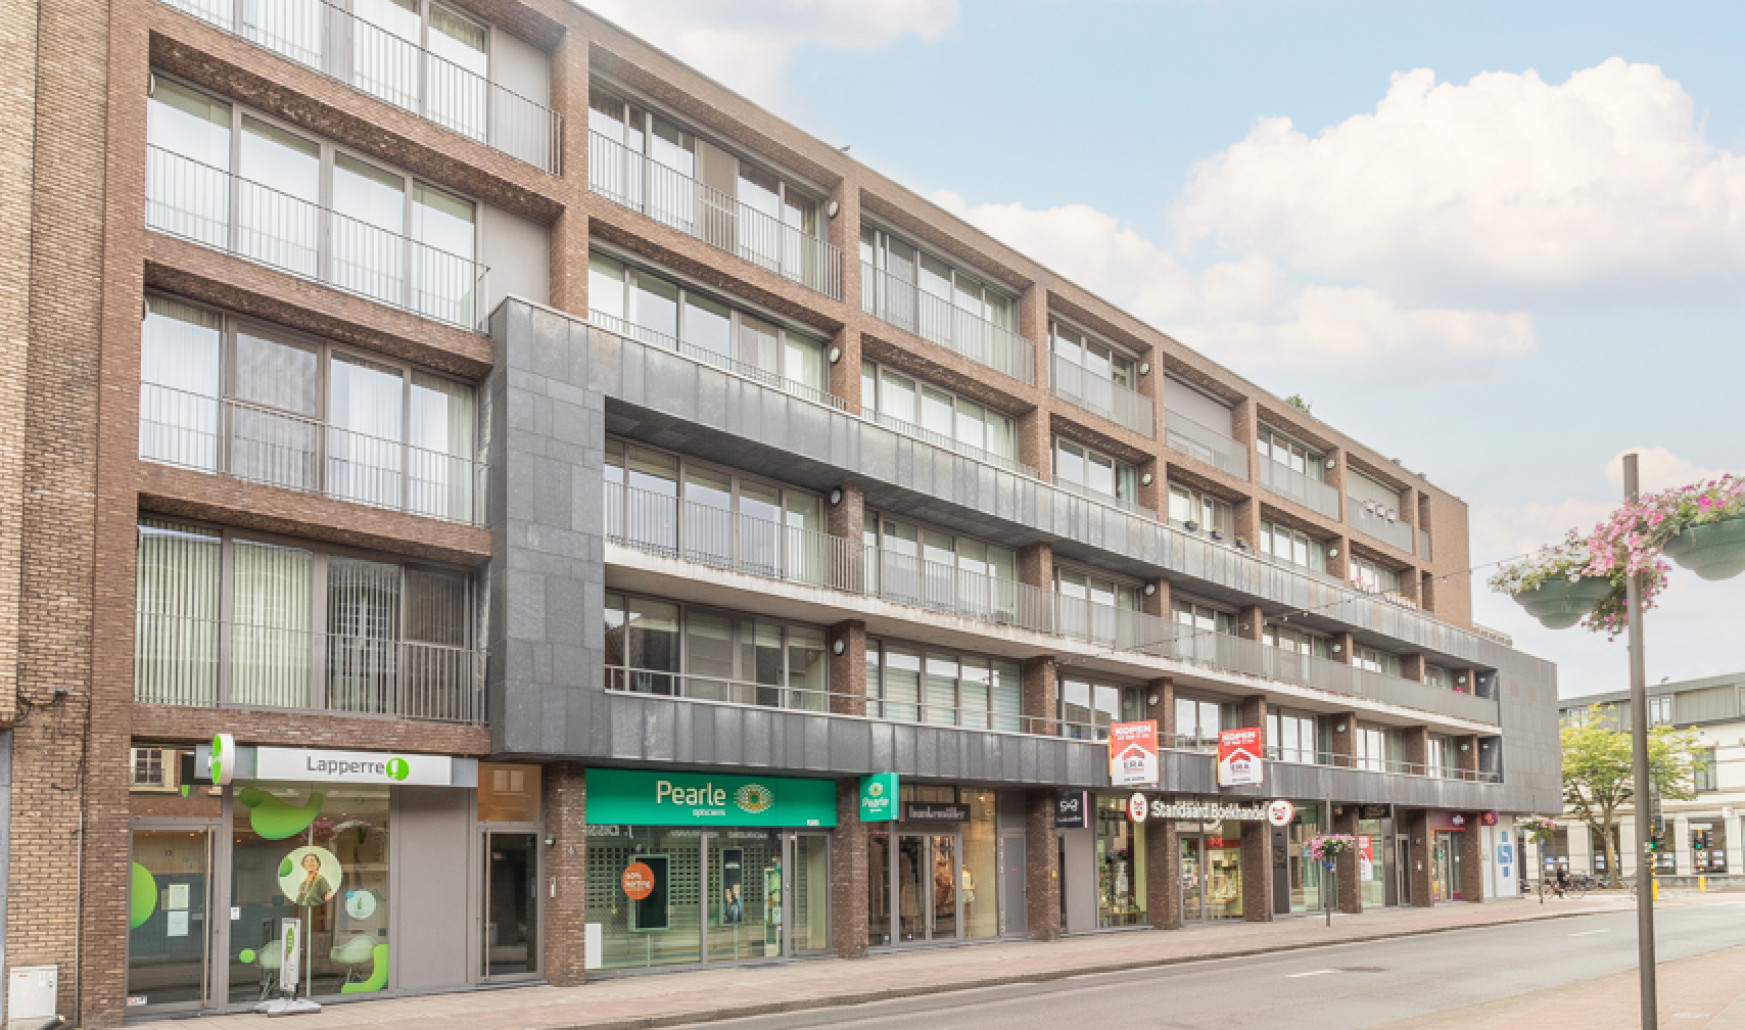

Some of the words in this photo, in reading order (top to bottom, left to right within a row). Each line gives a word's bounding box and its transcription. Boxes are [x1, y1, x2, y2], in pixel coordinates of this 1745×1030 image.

[1115, 725, 1151, 736] KOPEN
[1222, 732, 1256, 742] KOPEN
[306, 756, 385, 775] Lapperre
[656, 780, 726, 805] Pearle
[862, 797, 889, 808] Pearle
[1151, 800, 1208, 819] Standaard
[1210, 803, 1267, 821] Boekhandel
